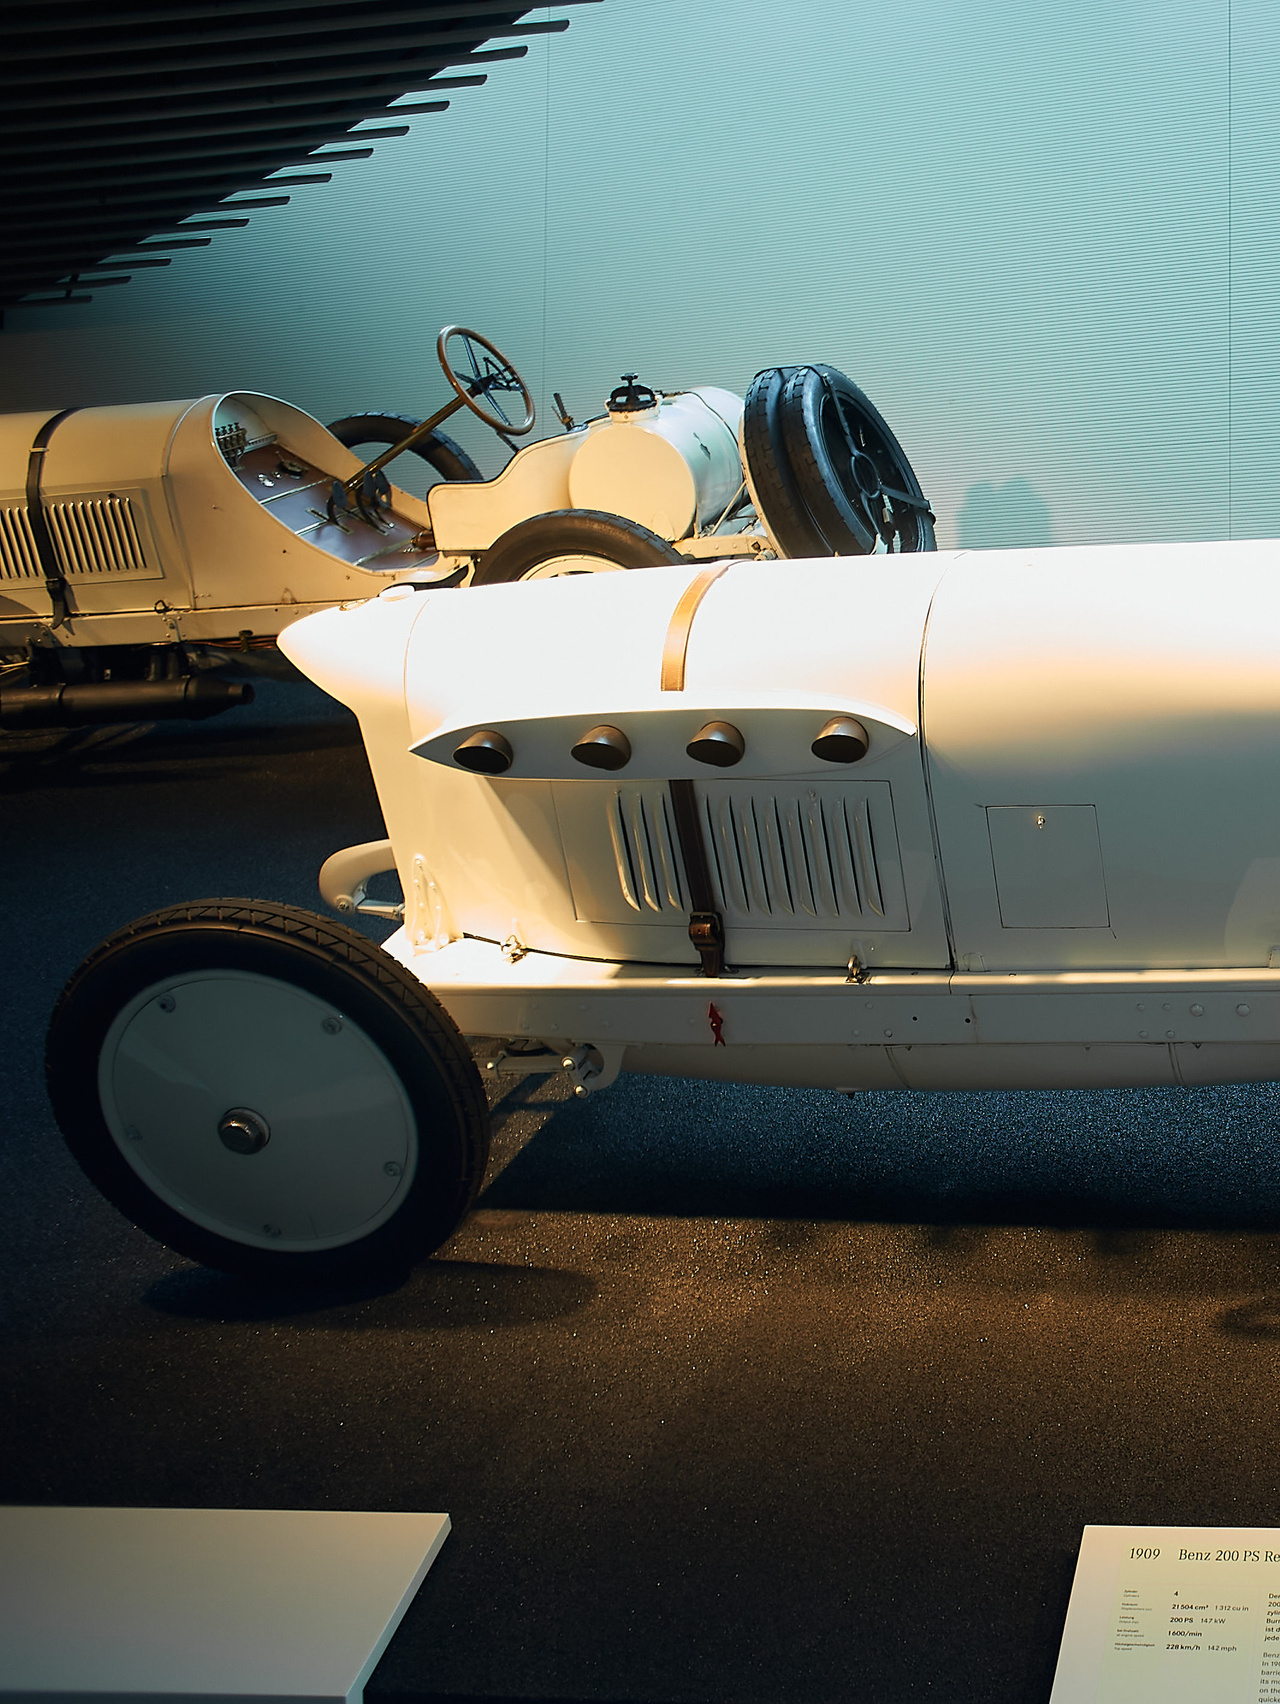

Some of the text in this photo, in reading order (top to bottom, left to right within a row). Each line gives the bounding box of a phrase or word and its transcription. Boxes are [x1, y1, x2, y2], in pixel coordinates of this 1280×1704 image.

[1129, 1547, 1161, 1560] 1909
[1179, 1548, 1211, 1561] Benz
[1215, 1549, 1240, 1561] 200
[1243, 1549, 1260, 1562] PS
